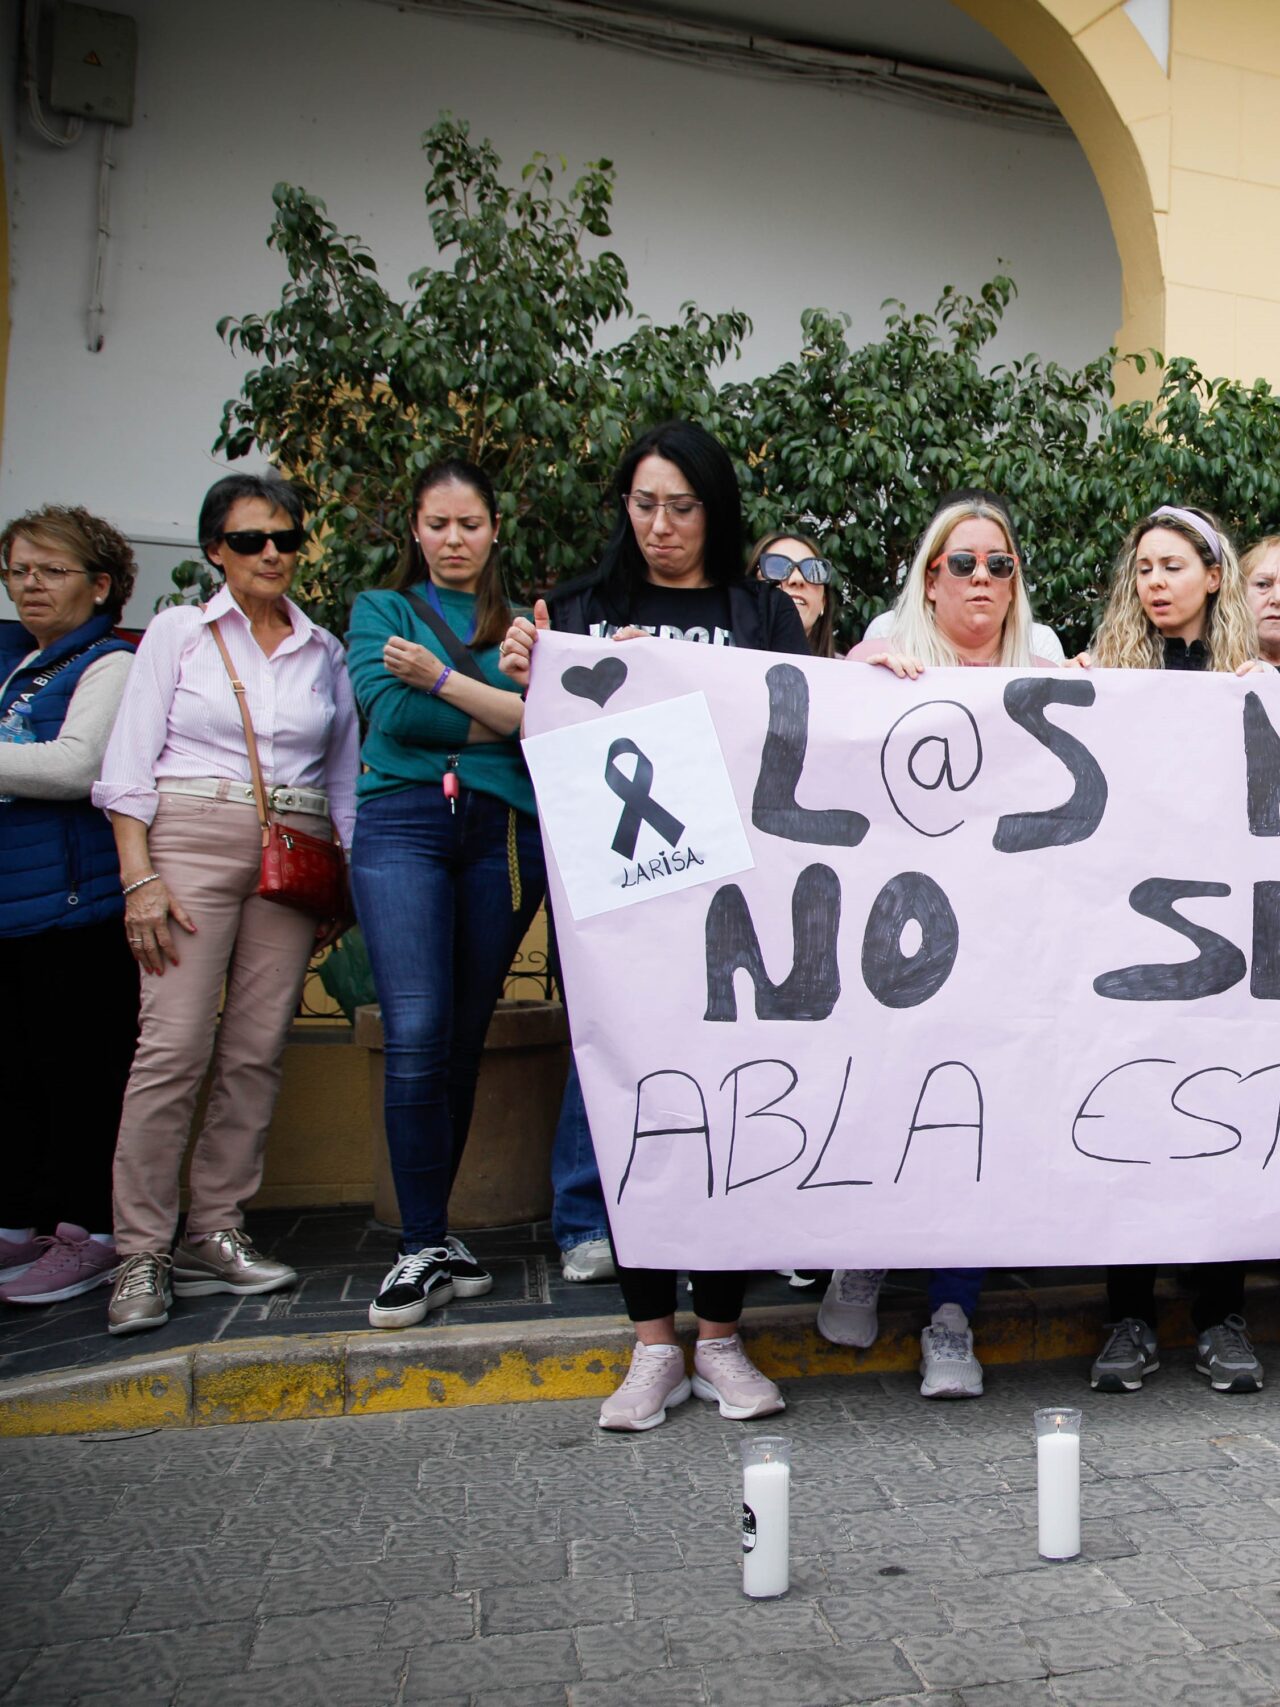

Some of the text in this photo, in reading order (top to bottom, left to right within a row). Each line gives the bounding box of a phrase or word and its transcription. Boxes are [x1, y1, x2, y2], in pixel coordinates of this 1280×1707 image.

[752, 662, 1108, 853] L@S
[703, 862, 960, 1023] NO
[617, 1056, 985, 1205] ABLA
